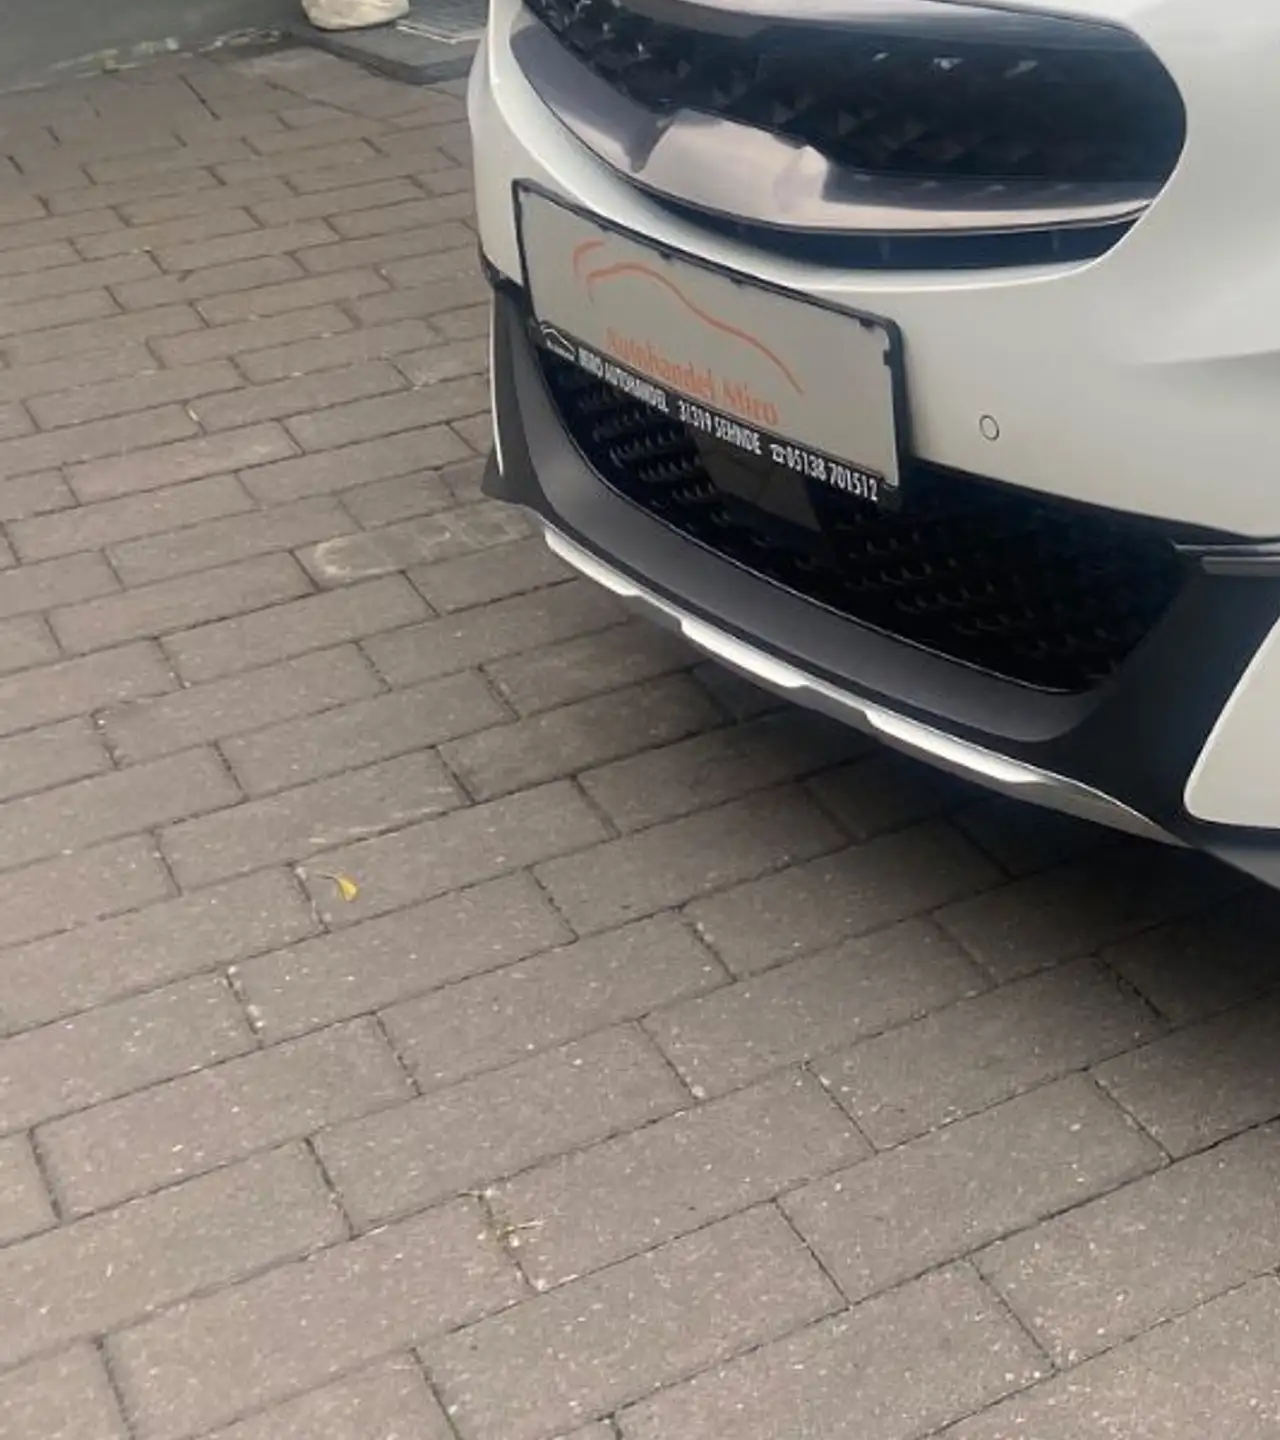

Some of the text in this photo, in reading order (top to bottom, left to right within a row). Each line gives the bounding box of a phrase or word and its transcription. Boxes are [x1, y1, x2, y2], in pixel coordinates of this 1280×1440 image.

[713, 416, 763, 456] SEHNDE
[786, 444, 827, 483] 05138
[826, 461, 879, 503] 701512
